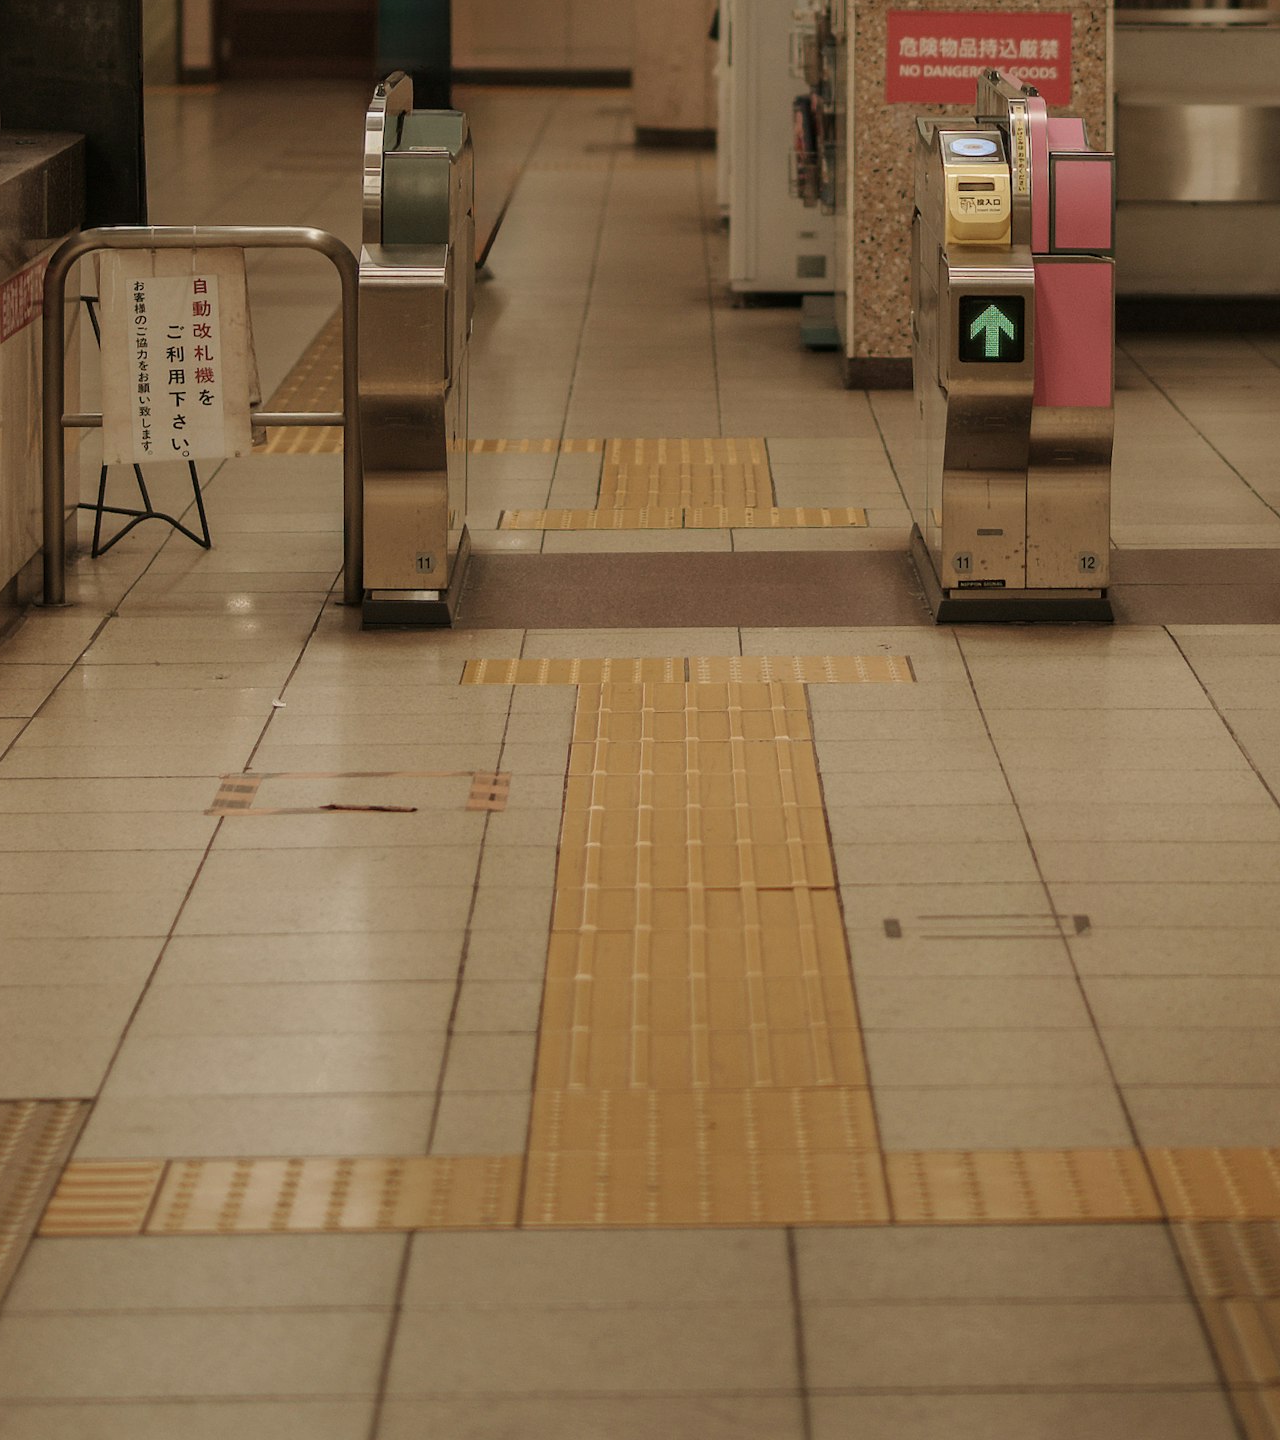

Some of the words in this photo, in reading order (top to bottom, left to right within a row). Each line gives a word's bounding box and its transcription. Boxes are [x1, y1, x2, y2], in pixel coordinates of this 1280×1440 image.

[899, 64, 921, 77] NO
[1008, 66, 1058, 79] GOODS
[192, 278, 216, 407] 自動改札機を
[418, 556, 430, 569] 11
[956, 556, 970, 569] 11
[1081, 556, 1096, 569] 12
